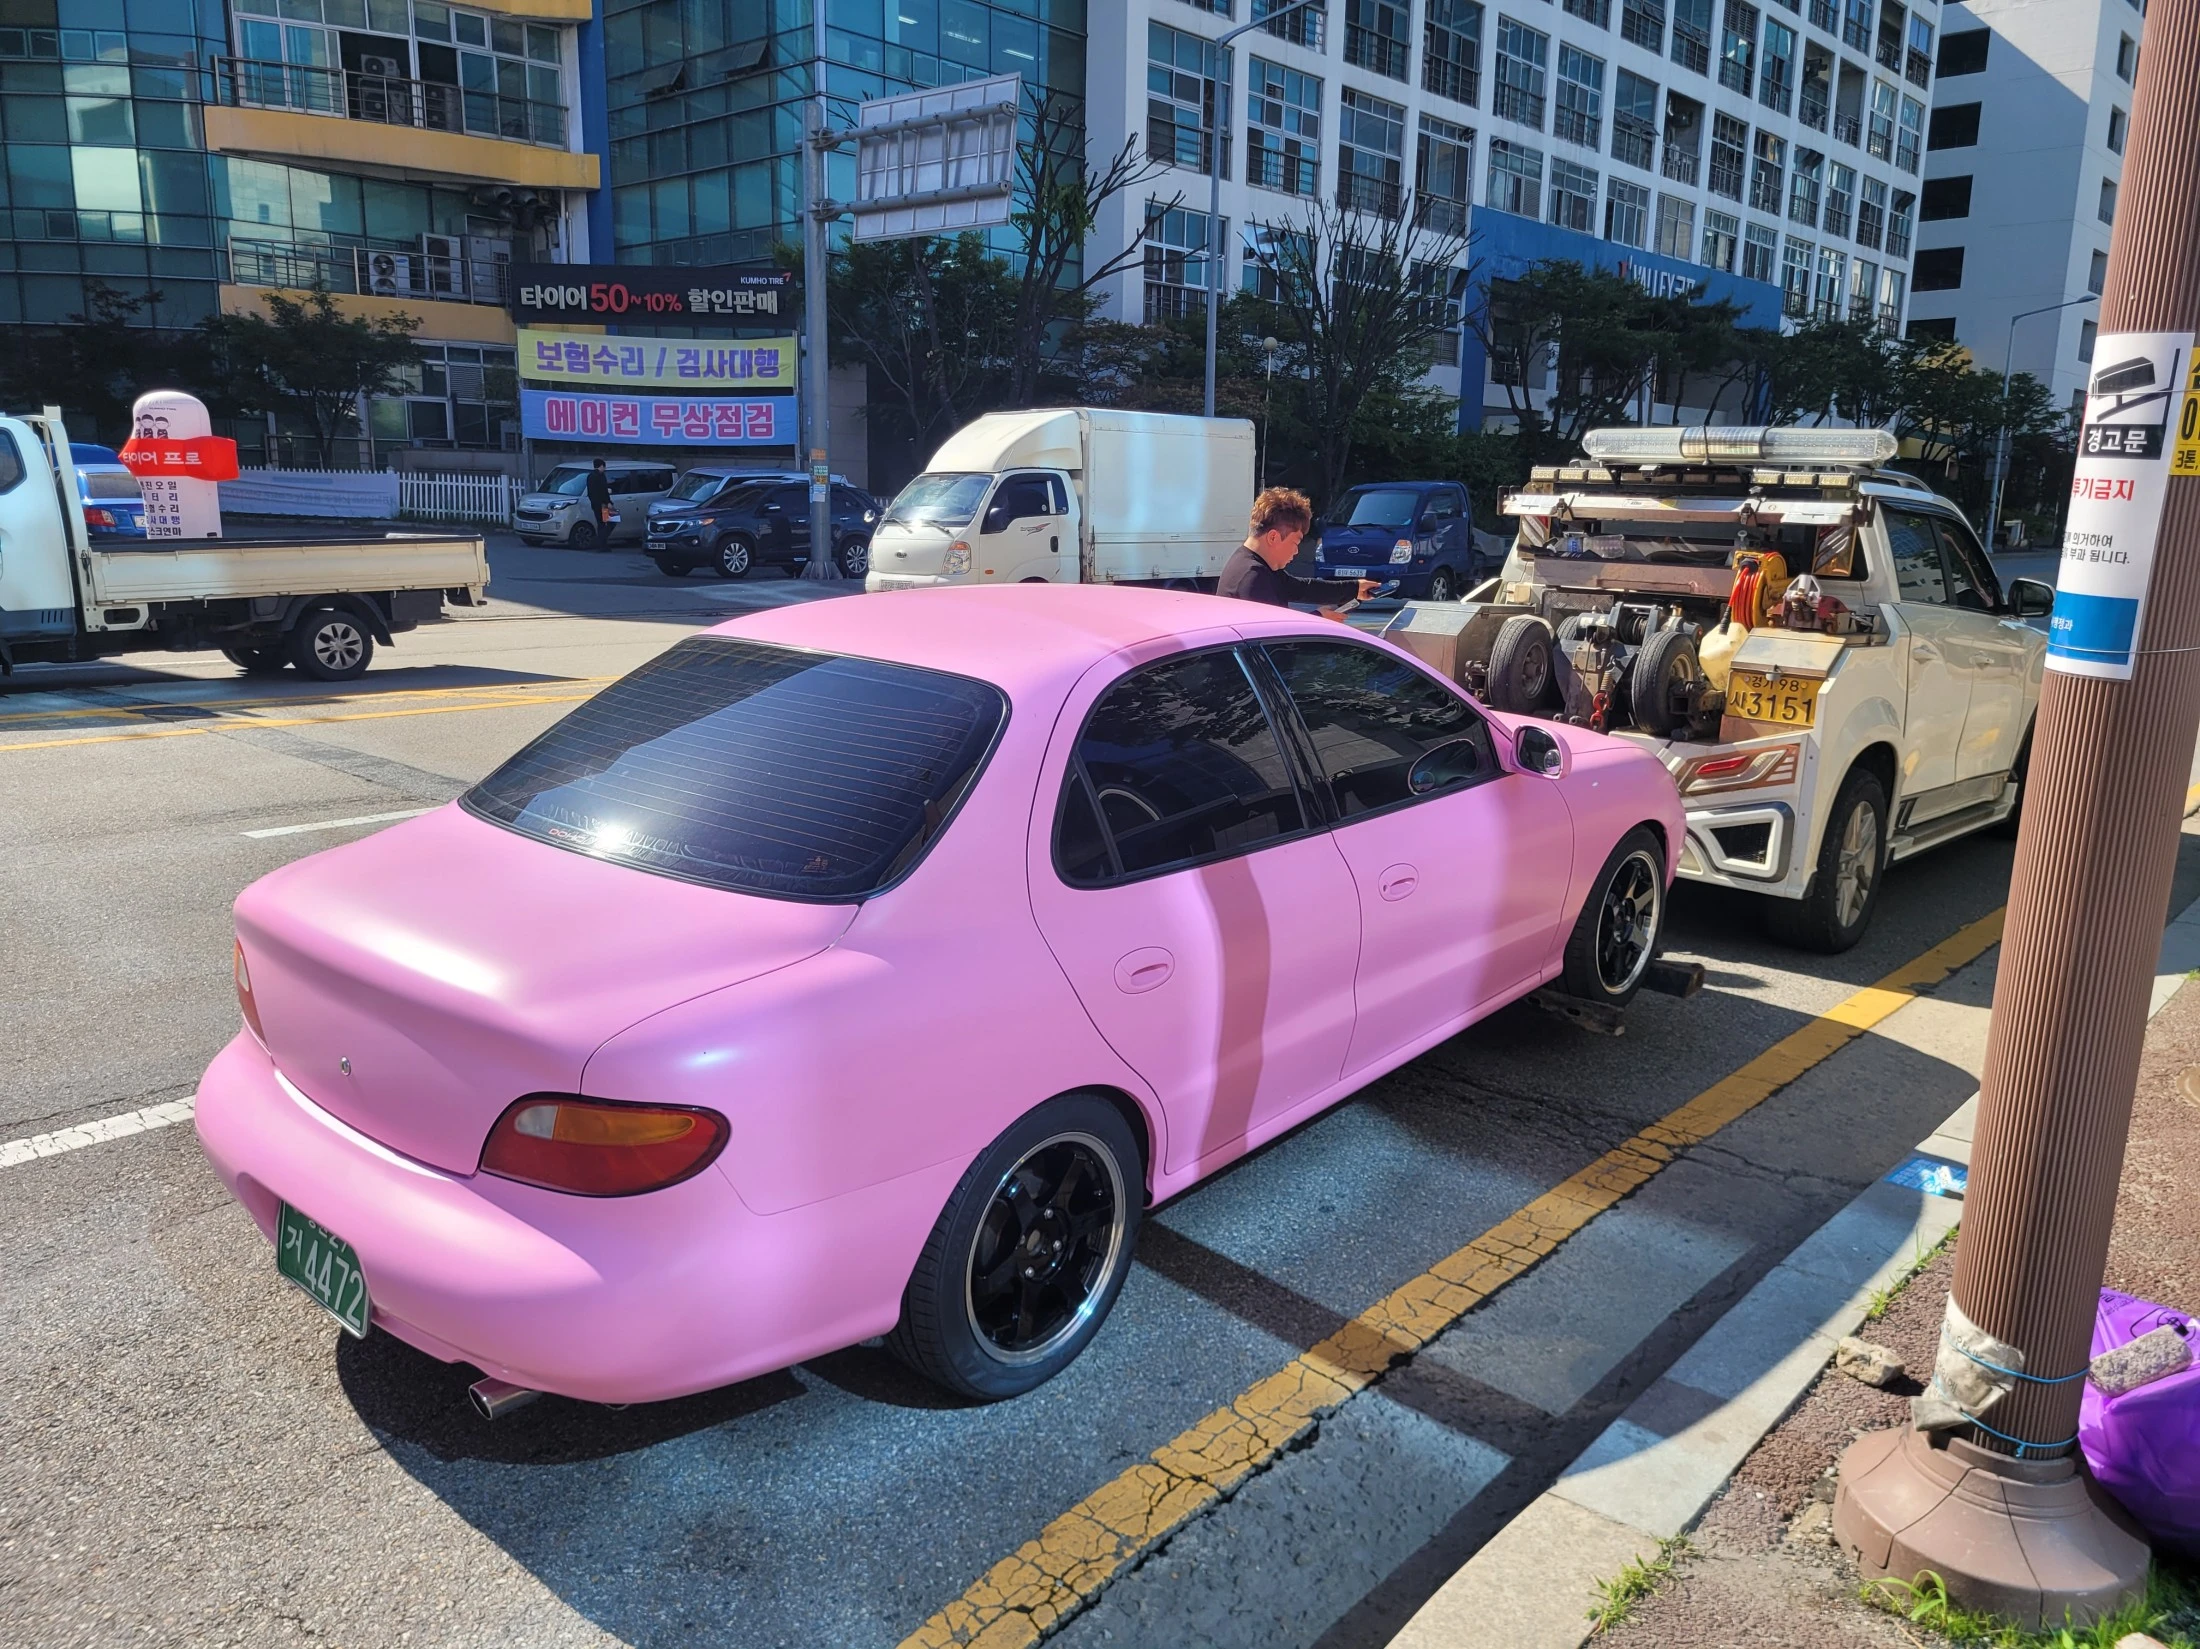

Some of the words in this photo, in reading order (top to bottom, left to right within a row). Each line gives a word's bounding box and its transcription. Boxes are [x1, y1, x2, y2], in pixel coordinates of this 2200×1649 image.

[740, 276, 768, 285] KUMHO
[768, 277, 784, 285] TIRE
[520, 285, 587, 310] 타이어
[687, 288, 778, 314] 할인판매
[536, 340, 645, 376] 보험수리
[655, 347, 666, 378] /
[677, 347, 780, 379] 검사대행
[546, 398, 639, 436] 에어컨
[652, 403, 775, 438] 무상점검
[2087, 427, 2147, 454] 경고문
[122, 451, 158, 466] 타이어
[163, 452, 202, 465] 프로
[2072, 532, 2113, 548] 의거하여
[2070, 547, 2086, 561] 부과
[2089, 549, 2130, 565] 됩니다.
[1752, 676, 1774, 690] 경기
[1780, 679, 1800, 692] 98
